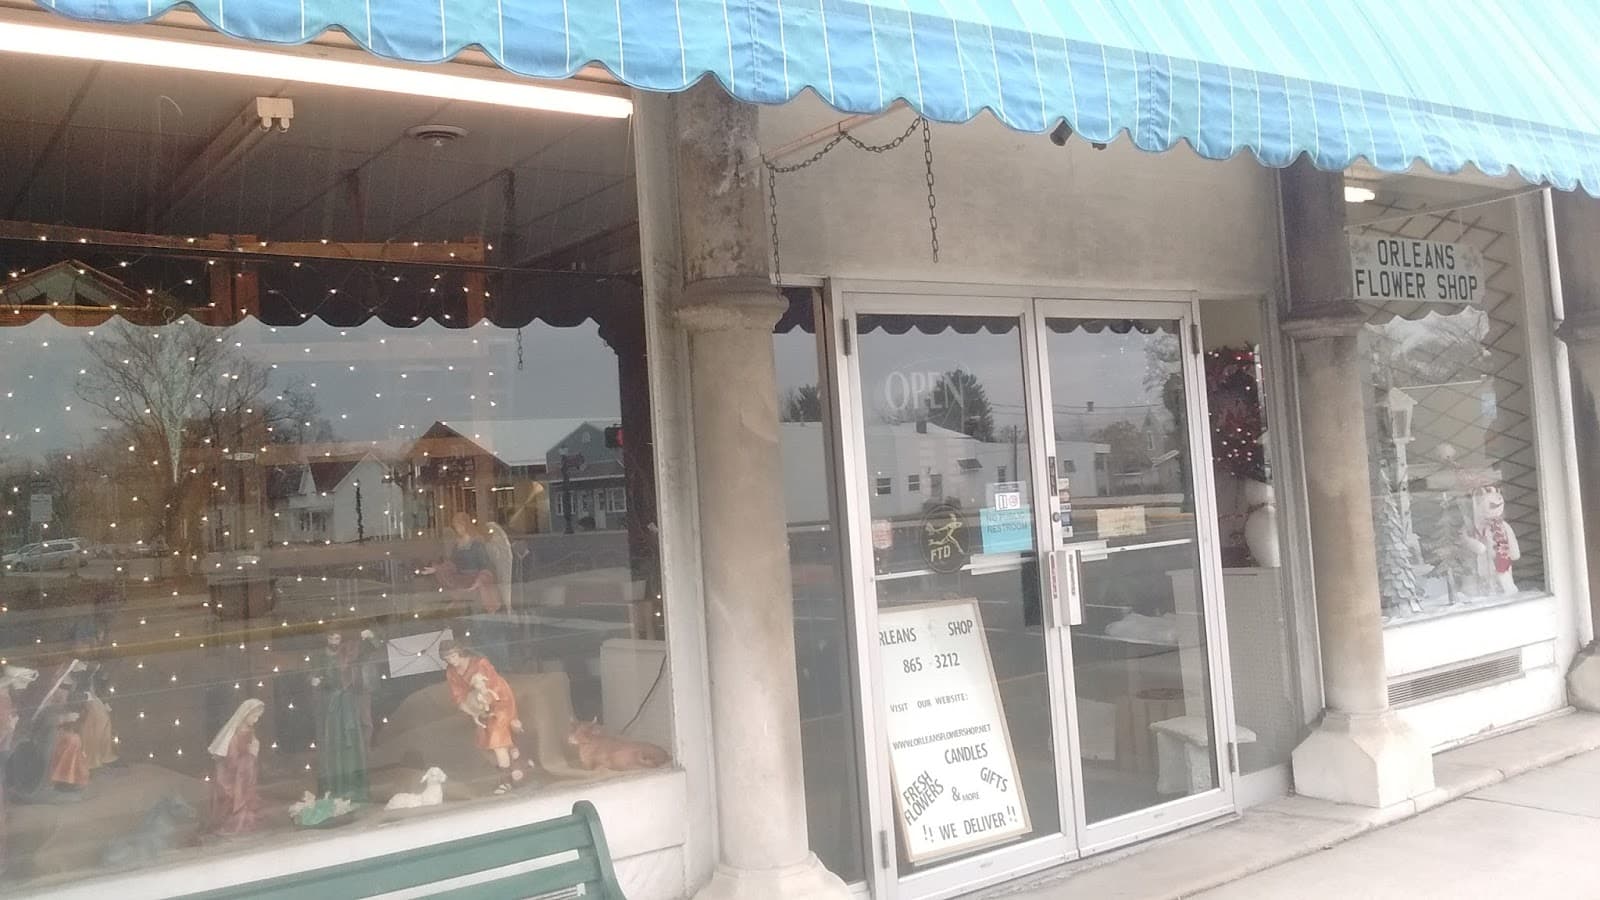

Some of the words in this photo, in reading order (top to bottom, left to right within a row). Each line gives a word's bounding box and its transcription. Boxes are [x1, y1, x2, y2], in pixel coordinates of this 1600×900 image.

[1377, 239, 1455, 270] ORLEANS
[1355, 269, 1426, 299] FLOWER
[1437, 273, 1478, 300] SHOP
[884, 371, 964, 410] OPEN
[930, 545, 951, 562] FTD
[878, 627, 917, 647] RLEANS
[947, 619, 973, 636] SHOP
[903, 657, 923, 674] 865
[934, 652, 961, 669] 3212
[889, 702, 909, 713] VISIT
[917, 699, 932, 709] OUR
[935, 692, 969, 705] WEBSITE:
[892, 723, 991, 750] WWW.ORLEANSFLOWERSHOP.NET
[944, 742, 988, 765] CANDLES
[902, 770, 933, 806] FRESH
[980, 767, 1008, 792] GIFTS
[904, 778, 944, 827] FLOWERS
[951, 785, 961, 802] &
[962, 791, 980, 802] MORE
[938, 822, 958, 841] WE
[963, 811, 1007, 836] DELIVER
